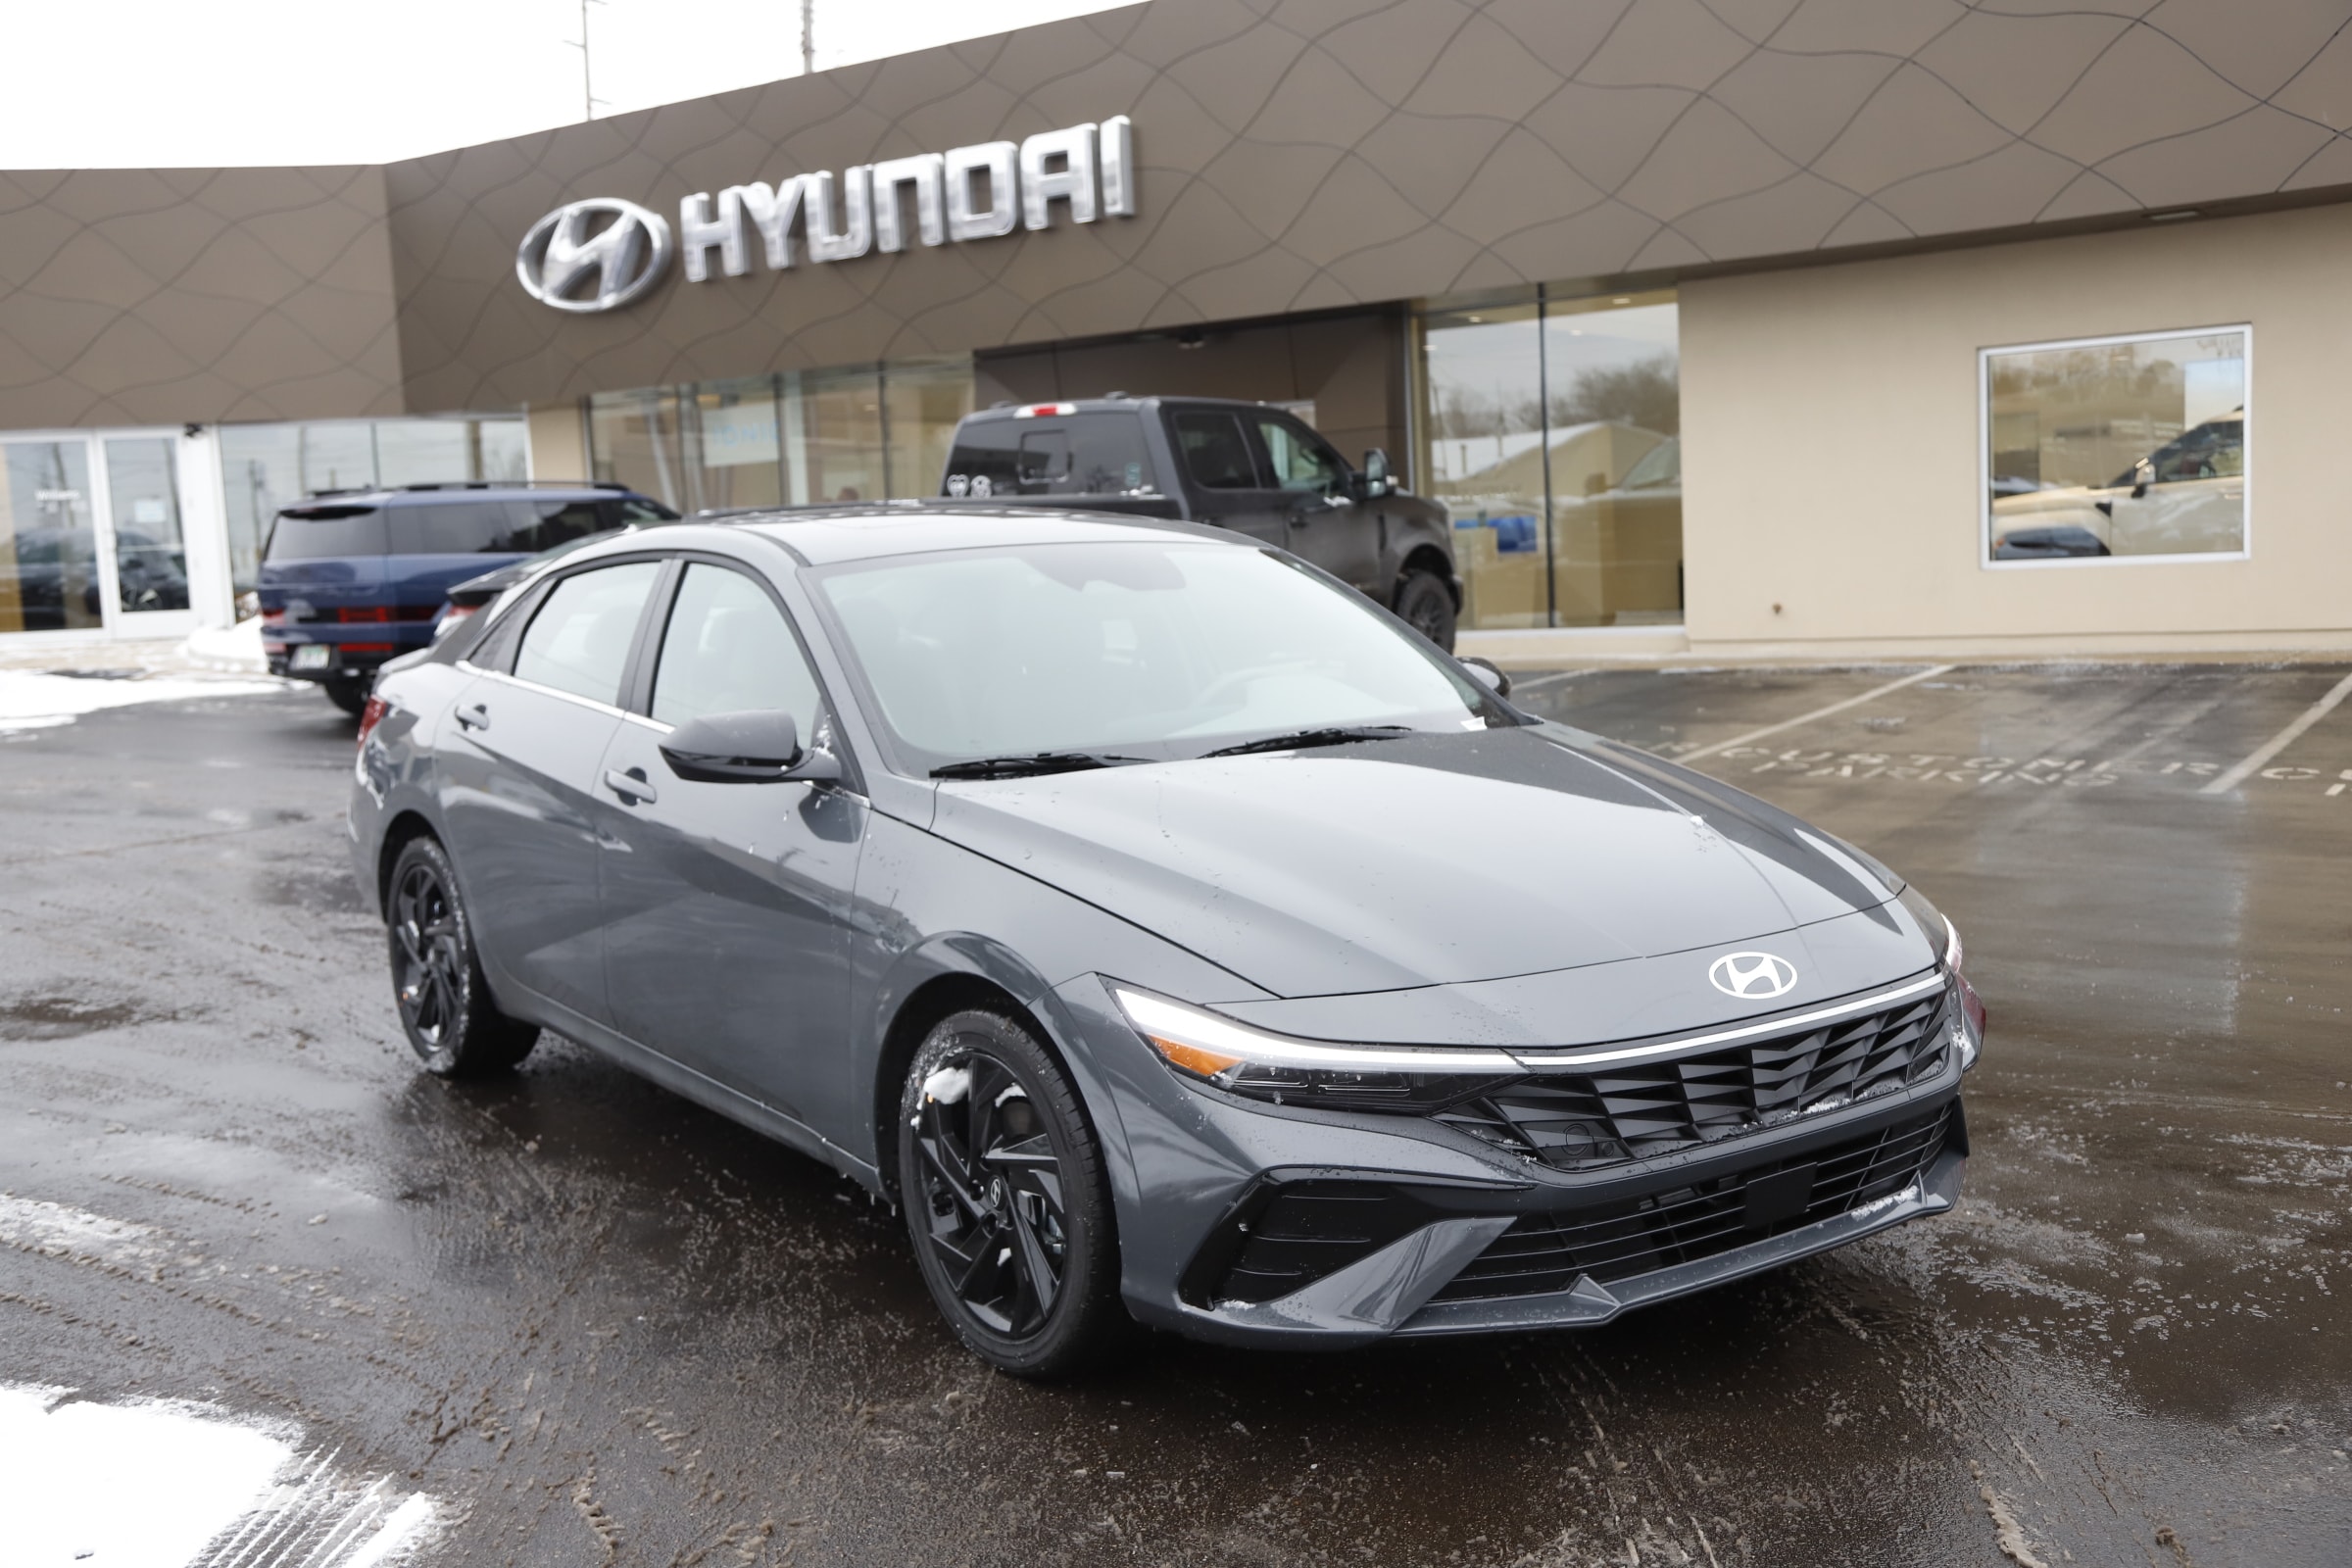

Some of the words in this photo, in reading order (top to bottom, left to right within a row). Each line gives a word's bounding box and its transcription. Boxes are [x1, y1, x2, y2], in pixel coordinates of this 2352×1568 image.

[680, 115, 1134, 282] HYUNDAI
[1720, 746, 2220, 774] CUSTOMER
[1750, 760, 2119, 786] PARKING
